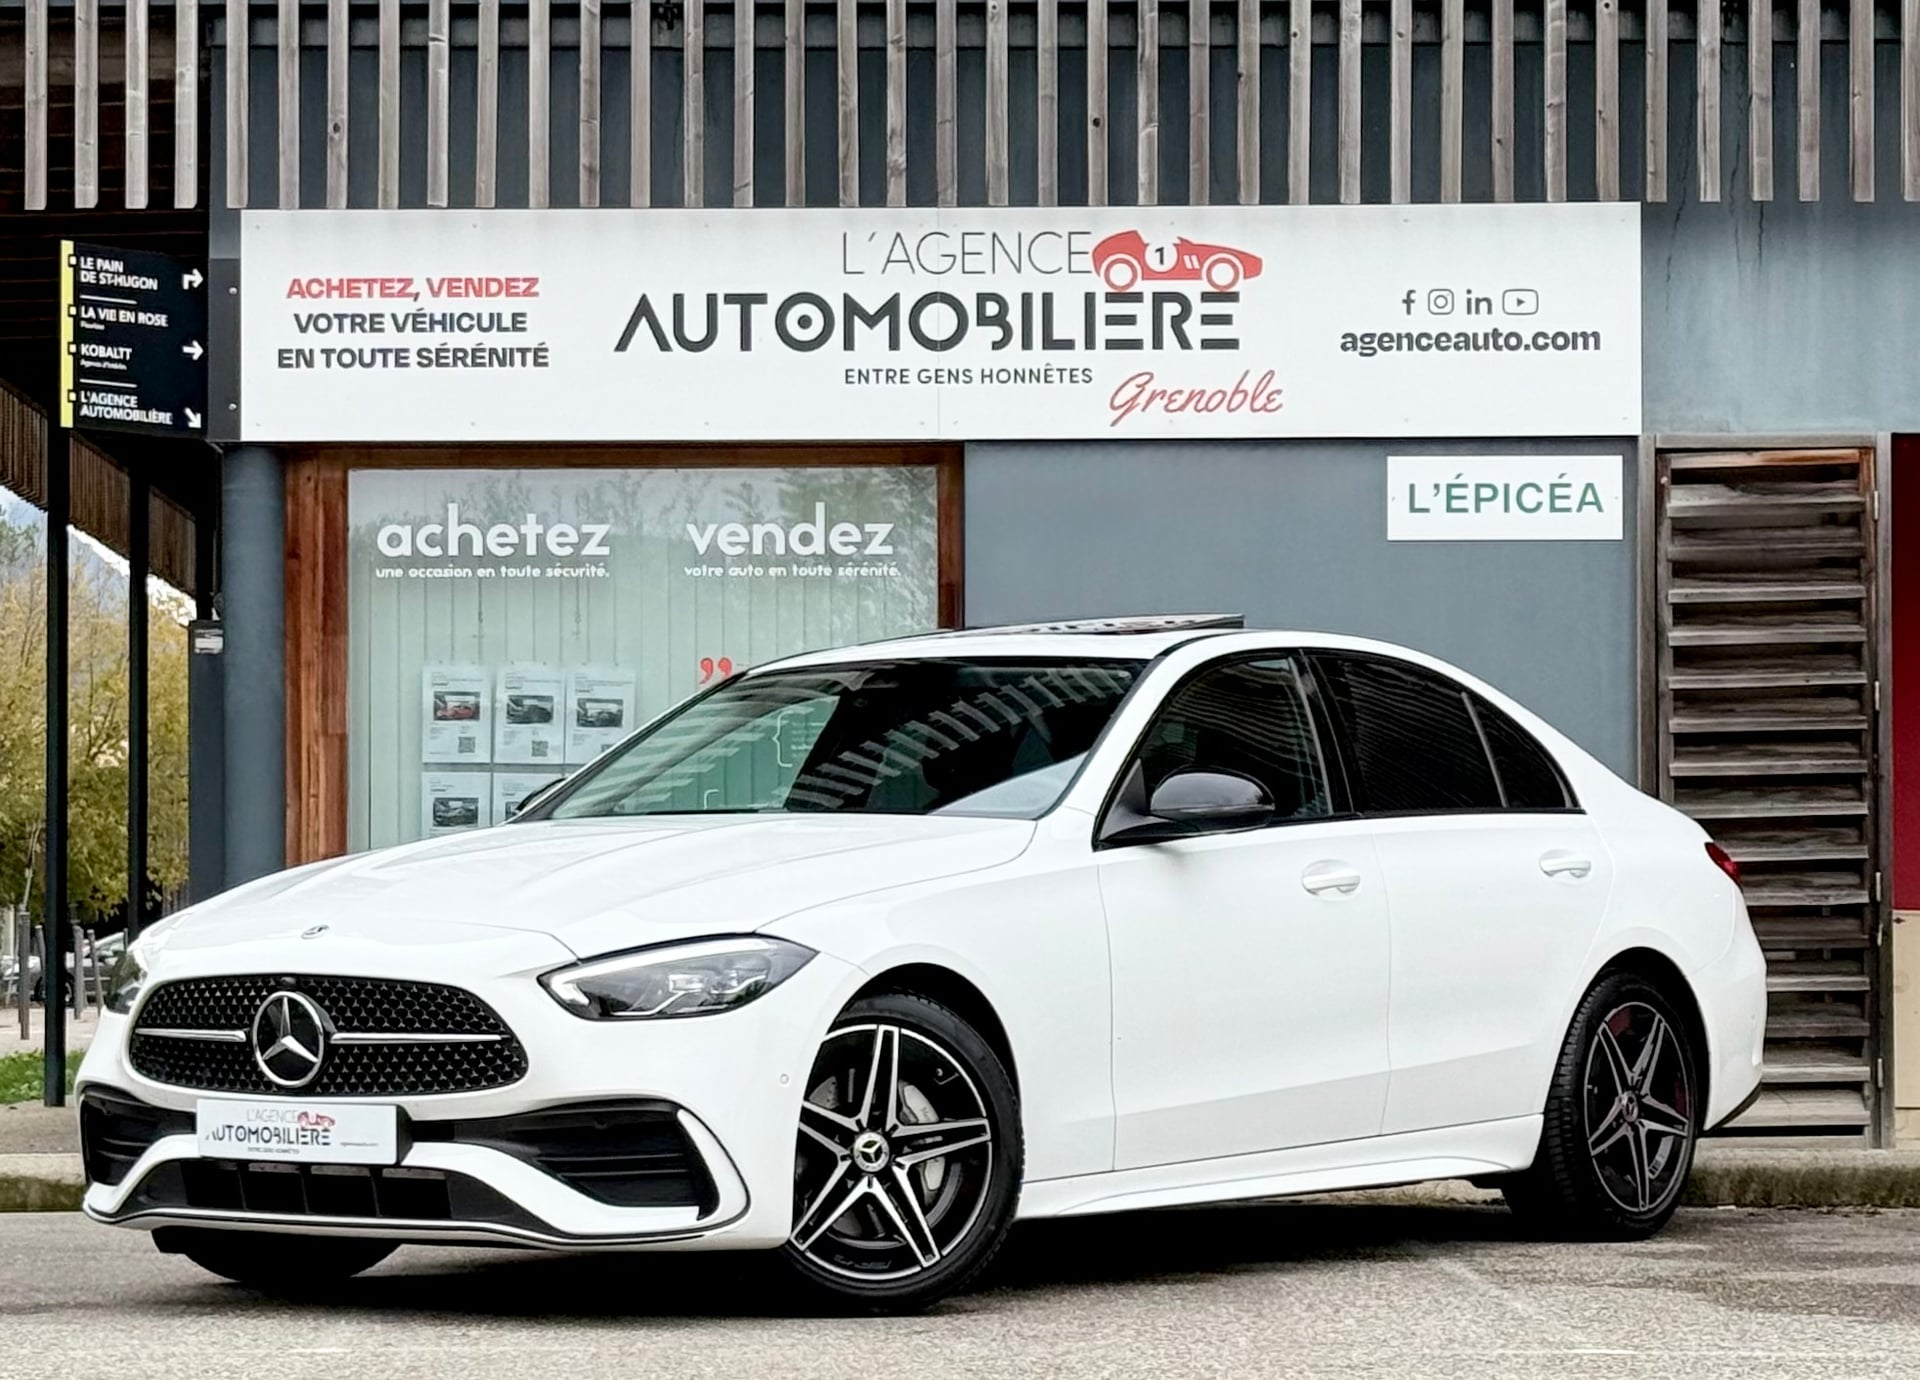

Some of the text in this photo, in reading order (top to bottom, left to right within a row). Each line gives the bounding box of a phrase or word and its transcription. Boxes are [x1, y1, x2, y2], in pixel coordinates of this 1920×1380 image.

[80, 256, 124, 272] LE PAIN
[843, 231, 1092, 275] L'AGENCE
[80, 271, 158, 290] DE ST-HUGON
[286, 277, 540, 301] ACHETEZ, VENDEZ
[80, 306, 168, 327] LA VIE EN ROSE
[294, 307, 528, 333] VOTRE VÉHICULE
[80, 343, 133, 361] KOBALTT
[1340, 328, 1601, 357] agenceauto.com
[277, 342, 550, 368] EN TOUTE SÉRÉNITÉ
[844, 363, 1093, 385] ENTRE GENS HONNÊTES
[80, 390, 138, 408] L'AGENCE
[1109, 369, 1284, 428] Grenoble
[80, 404, 173, 425] AUTOMOBILIÈRE
[1408, 473, 1604, 513] L'ÉPICÉA
[376, 502, 611, 558] achetez
[687, 502, 895, 557] vendez
[375, 563, 610, 578] une occasion en toute sécurité.
[684, 564, 724, 577] votre
[728, 564, 764, 577] auto
[768, 566, 787, 577] en
[792, 564, 832, 577] toute
[246, 1108, 299, 1124] L'AGENCE
